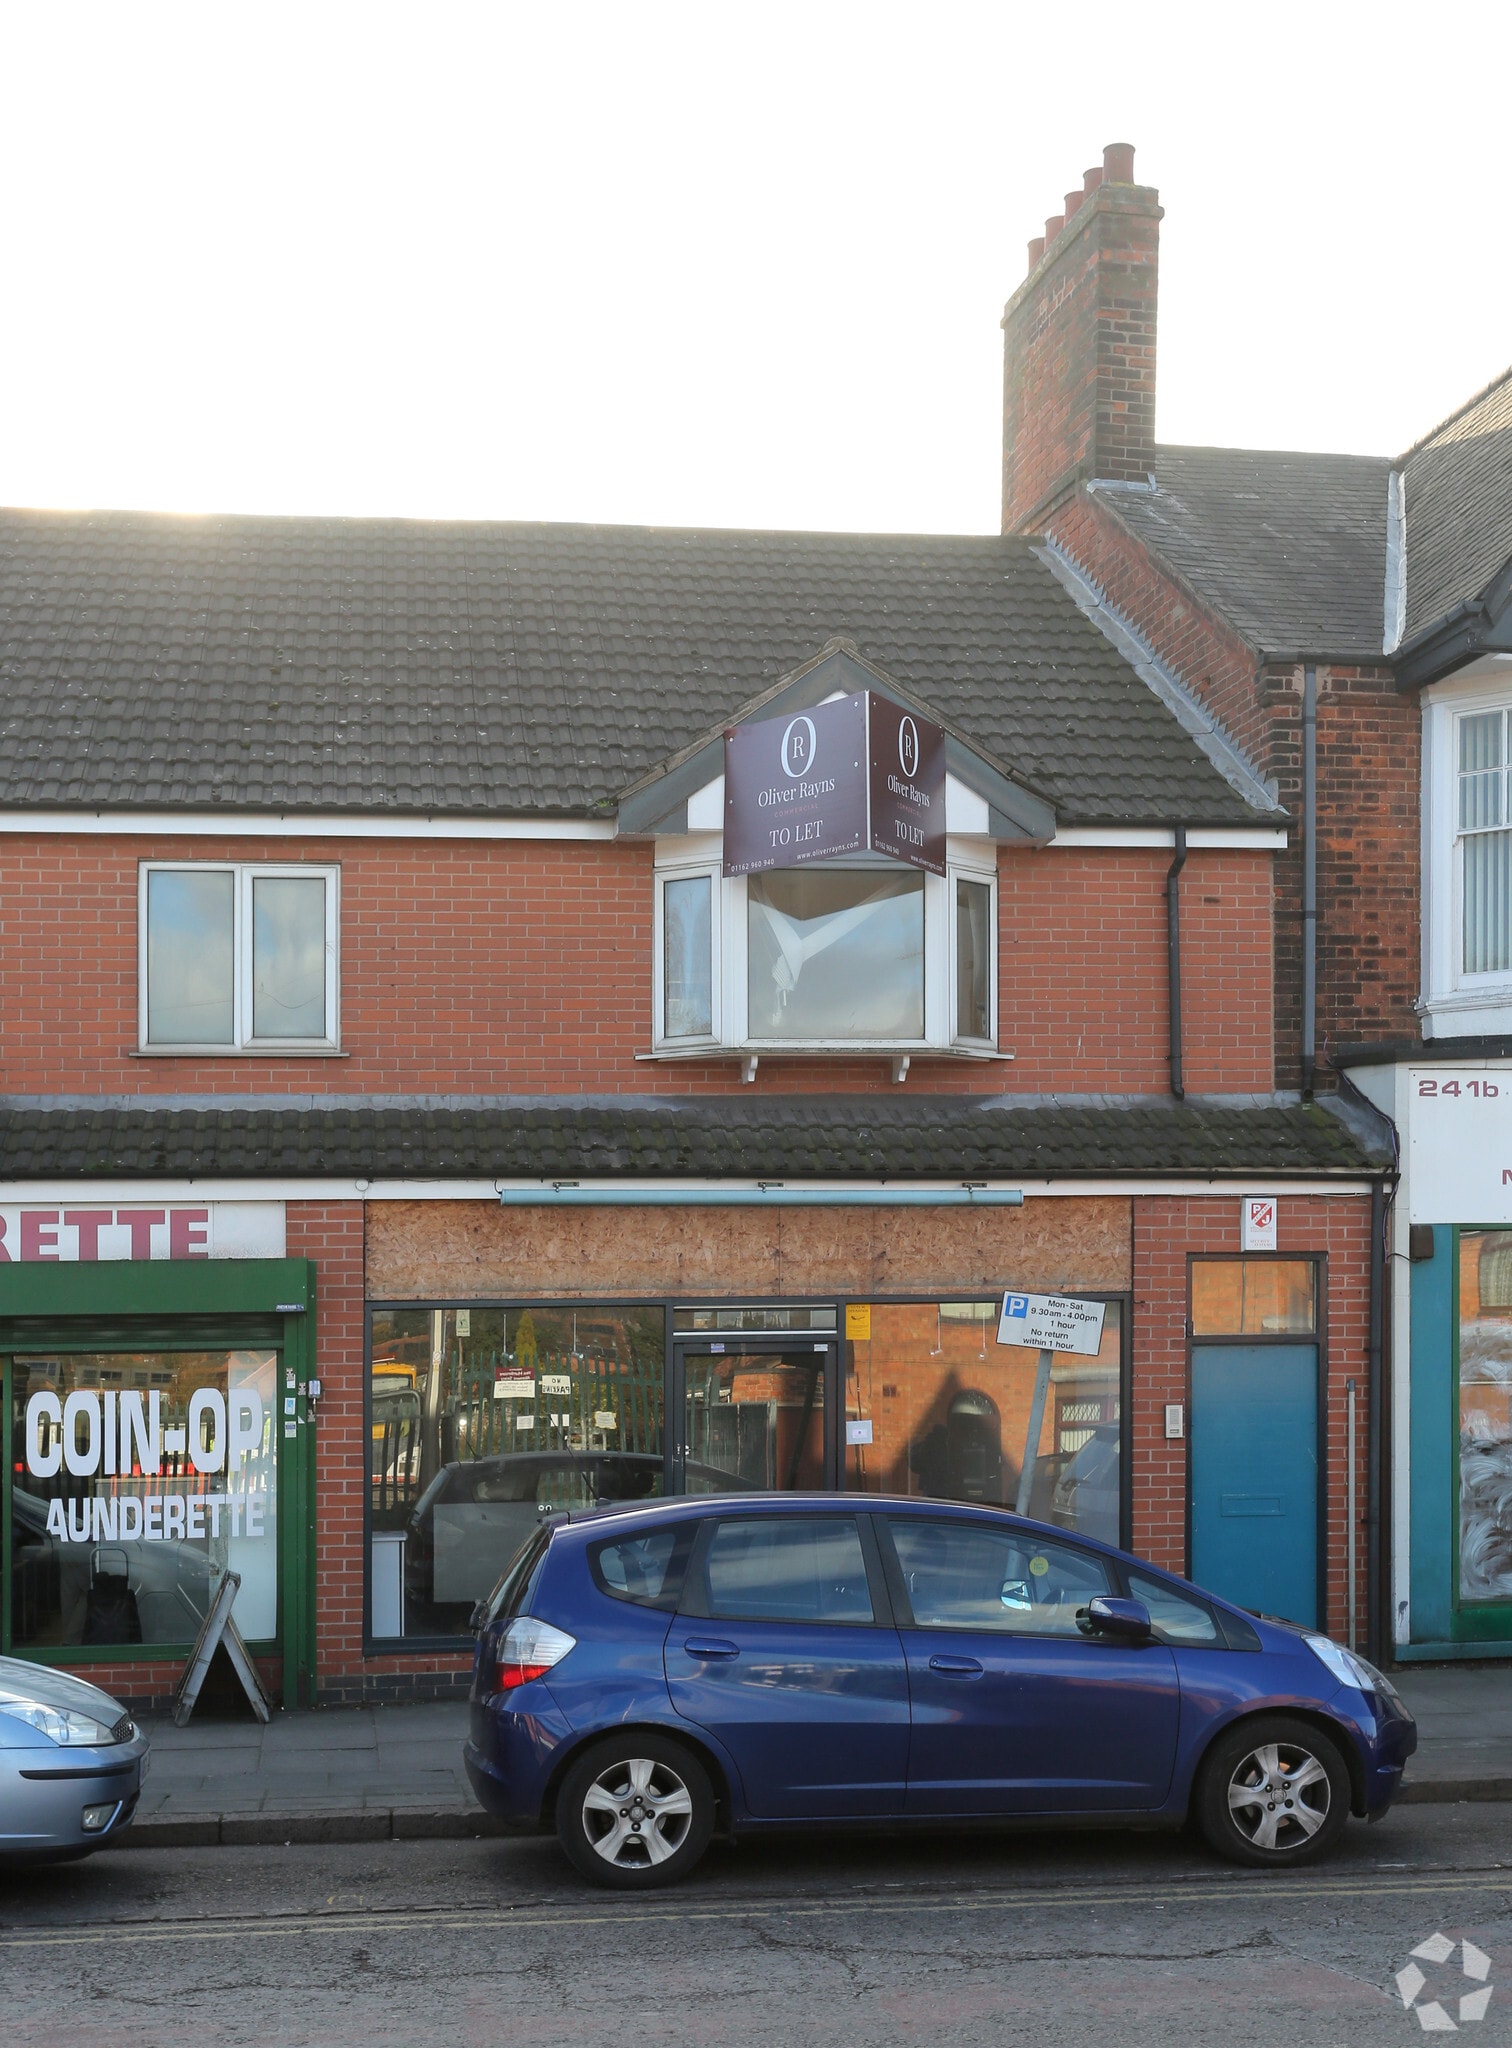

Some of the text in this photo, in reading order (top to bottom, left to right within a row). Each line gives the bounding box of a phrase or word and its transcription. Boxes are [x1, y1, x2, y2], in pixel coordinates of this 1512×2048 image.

[758, 778, 835, 808] Oliver Rayns
[887, 774, 931, 808] Oliver Rayns
[774, 803, 819, 818] COMMERCIAL
[769, 820, 824, 848] TO LET
[895, 819, 925, 847] TO LET
[796, 841, 860, 861] www.oliverrayns.com
[730, 863, 749, 873] 01162
[1418, 1080, 1499, 1098] 241b
[1008, 1297, 1025, 1316] P
[1030, 1328, 1069, 1340] No return
[1057, 1321, 1076, 1330] hour
[1023, 1337, 1074, 1350] within 1 hour
[26, 1388, 264, 1478] COIN-OP
[46, 1494, 265, 1543] AUNDERETTE
